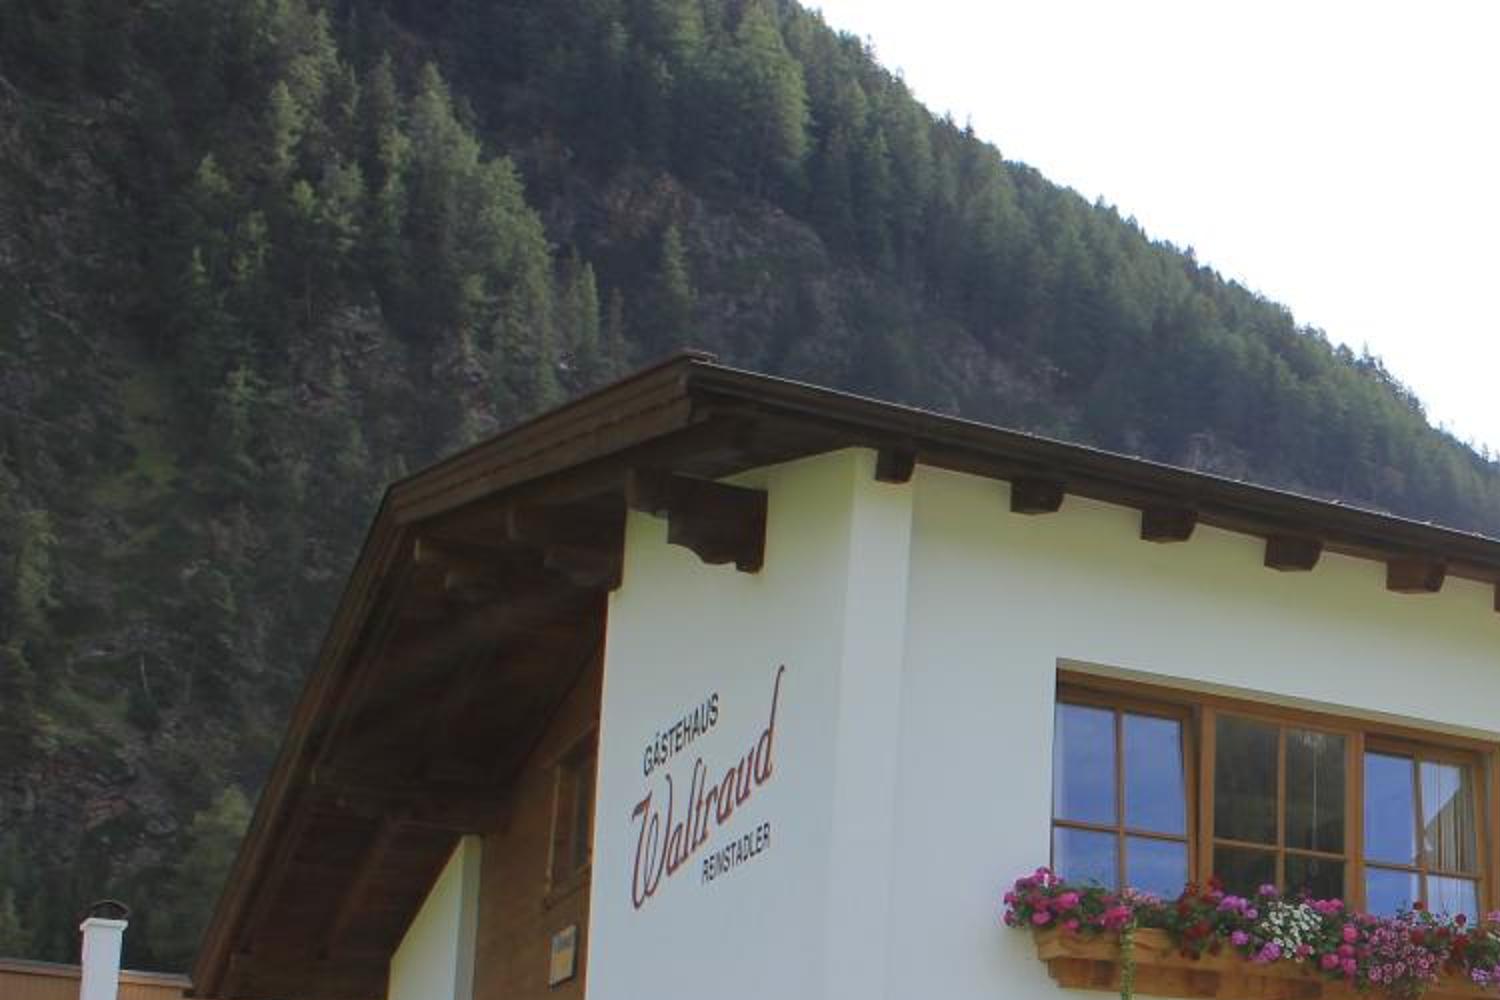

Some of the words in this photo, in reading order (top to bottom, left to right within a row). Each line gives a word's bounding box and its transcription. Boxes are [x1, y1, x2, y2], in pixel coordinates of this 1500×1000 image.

[643, 693, 719, 777] GÄSTEHAUS
[631, 664, 785, 910] Waltraud
[702, 822, 771, 884] REINSTADLER
